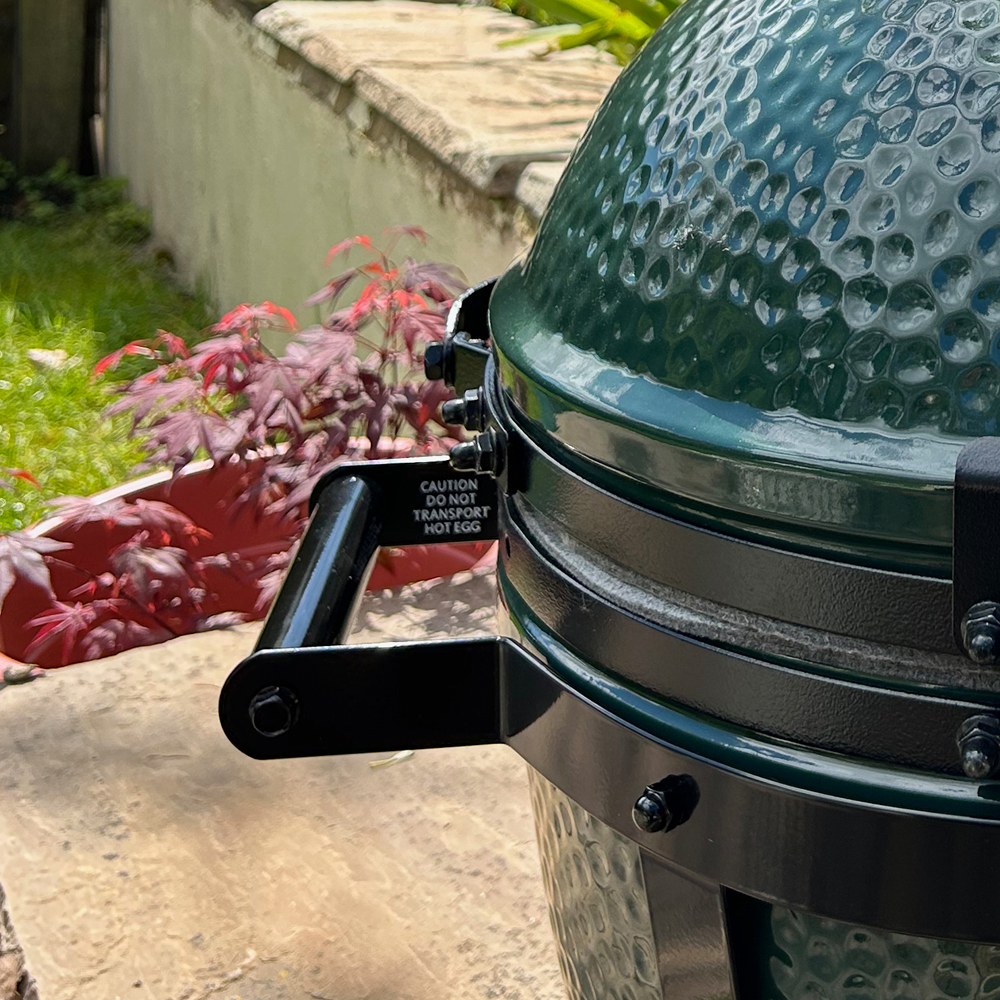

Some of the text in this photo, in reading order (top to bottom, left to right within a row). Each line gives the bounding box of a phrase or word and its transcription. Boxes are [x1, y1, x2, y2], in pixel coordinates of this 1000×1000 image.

[420, 479, 478, 493] CAUTION
[426, 492, 477, 507] DO NOT
[413, 506, 492, 522] TRANSPORT
[424, 520, 482, 535] HOT EGG
